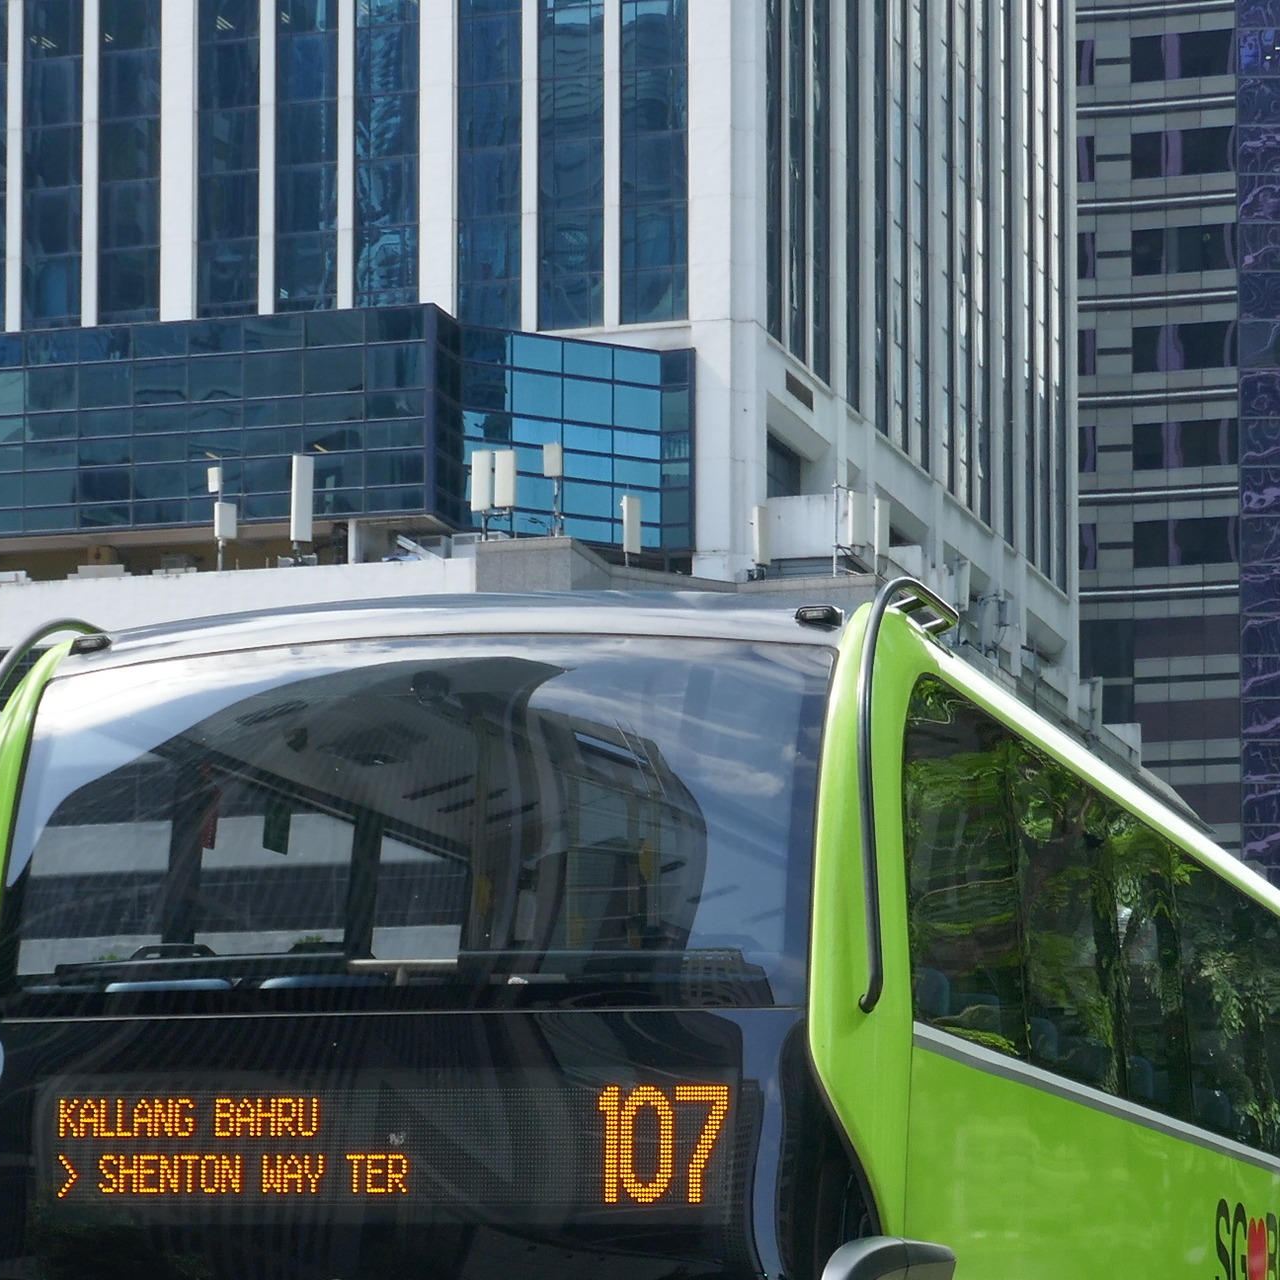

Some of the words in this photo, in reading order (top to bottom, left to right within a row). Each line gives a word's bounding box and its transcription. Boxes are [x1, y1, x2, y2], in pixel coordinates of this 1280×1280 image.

[58, 1098, 194, 1138] KALLANG
[214, 1098, 318, 1138] BAHRU
[597, 1085, 730, 1204] 107
[97, 1154, 241, 1194] SHENTON
[261, 1154, 325, 1194] WAY
[346, 1154, 410, 1194] TER
